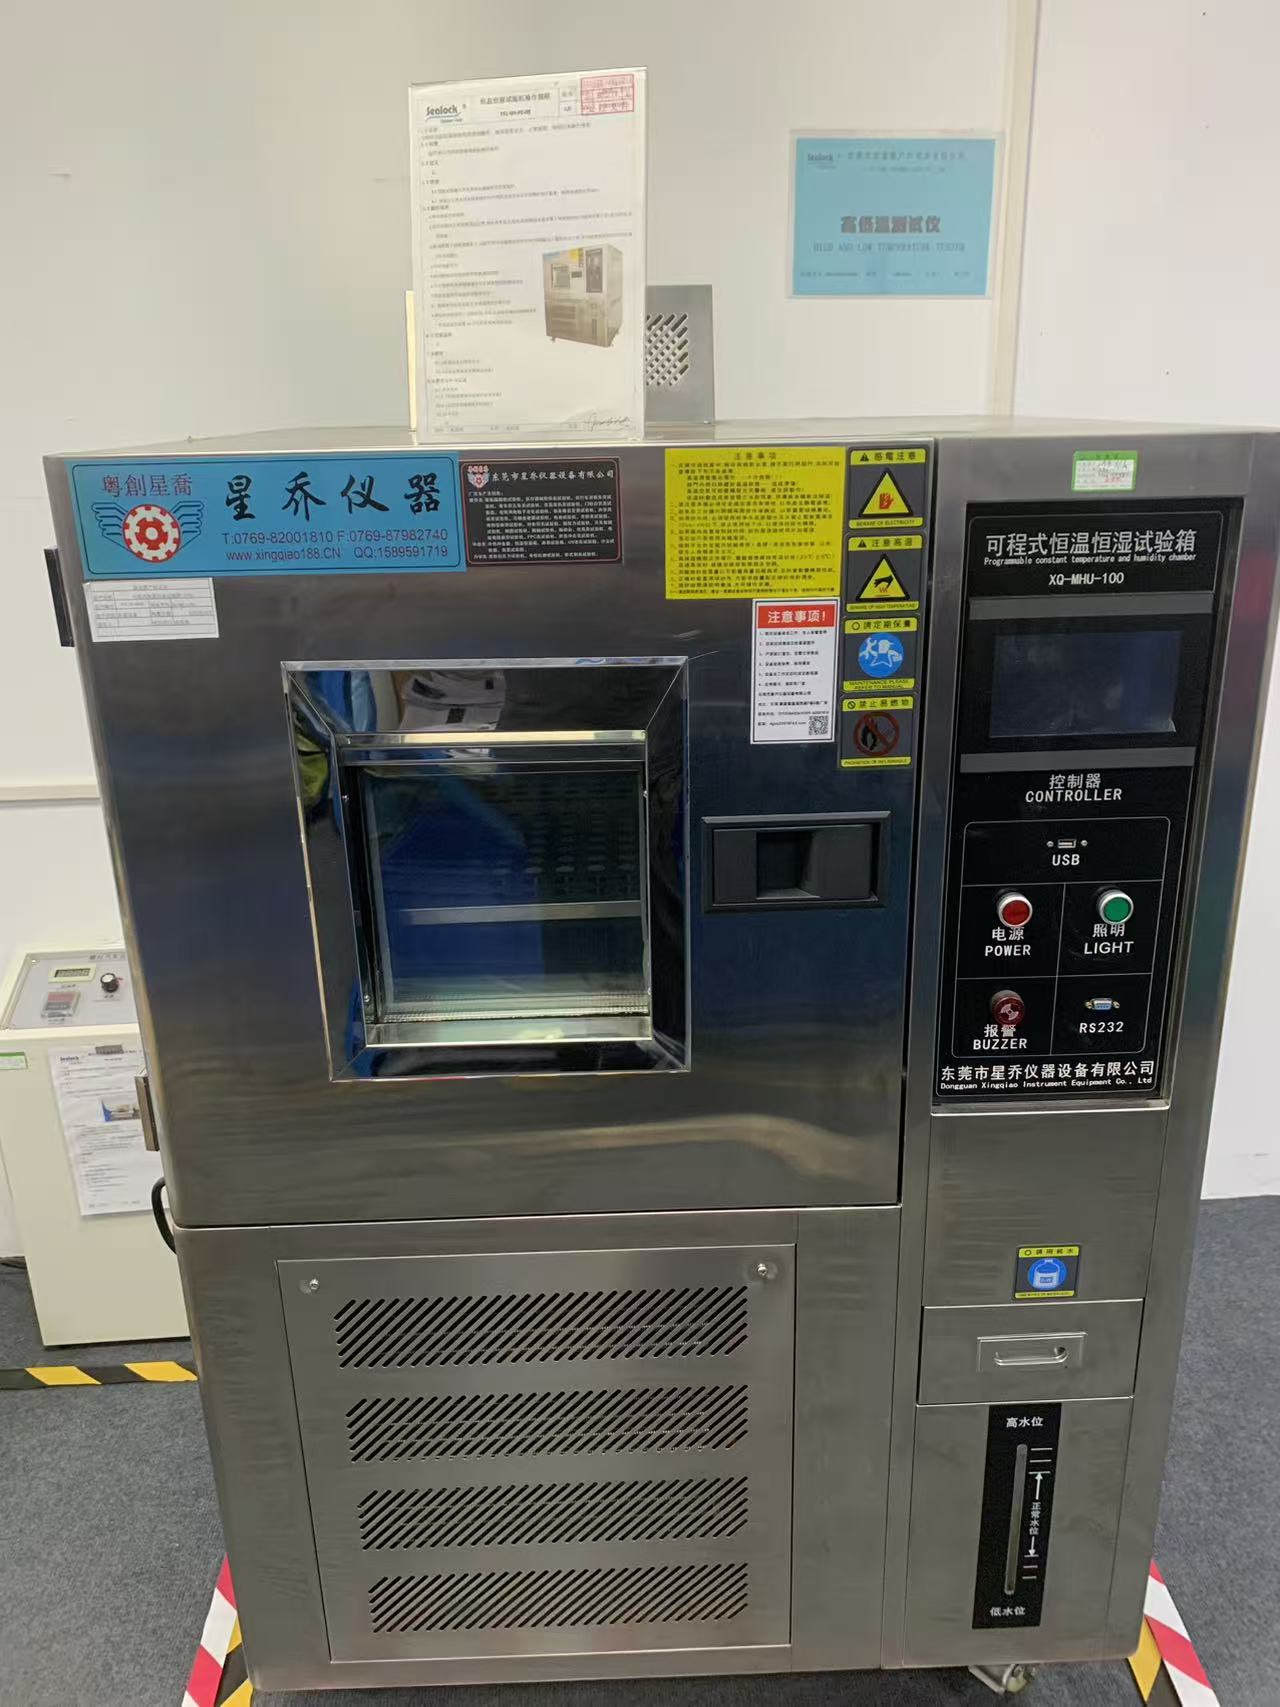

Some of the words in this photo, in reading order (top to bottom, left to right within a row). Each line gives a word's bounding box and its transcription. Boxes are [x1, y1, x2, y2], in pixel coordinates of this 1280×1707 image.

[426, 104, 458, 116] Sealock
[840, 215, 941, 233] 高低温测试仪
[492, 469, 614, 482] 东莞市星乔仪器设备有限公司
[225, 471, 442, 522] 星乔仪器
[222, 530, 333, 545] T:0769-82001810
[337, 528, 448, 543] F:0769-87982740
[985, 529, 1197, 557] 可程式恒温恒湿试验箱
[226, 546, 341, 562] www.xingqiao188.CN
[353, 545, 448, 559] QQ:1589591719
[984, 556, 1033, 567] Programmable
[1035, 555, 1068, 565] constant
[1071, 554, 1115, 565] temperature
[1118, 554, 1131, 562] and
[1134, 553, 1167, 563] humidity
[1168, 552, 1197, 562] chamber
[1048, 571, 1125, 586] XQ-MHU-100
[1049, 773, 1101, 789] 控制器
[1025, 788, 1123, 803] CONTROLLER
[1052, 854, 1081, 867] USB
[992, 926, 1025, 942] 电源
[1092, 923, 1125, 938] 照明
[985, 944, 1032, 957] POWER
[1084, 941, 1134, 955] LIGHT
[984, 1023, 1017, 1038] 报警
[1079, 1021, 1124, 1034] RS232
[973, 1038, 1028, 1050] BUZZER
[941, 1060, 1155, 1081] 东莞市星乔仪器设备有限公司
[940, 1082, 978, 1090] Dongguan
[981, 1081, 1019, 1090] Xingqiao
[1023, 1080, 1067, 1088] Instrument
[1071, 1079, 1112, 1087] Equipment
[1137, 1076, 1153, 1084] Ltd
[1006, 1416, 1044, 1428] 高水位
[1029, 1501, 1042, 1536] 正常水位
[989, 1606, 1026, 1617] 低水位
